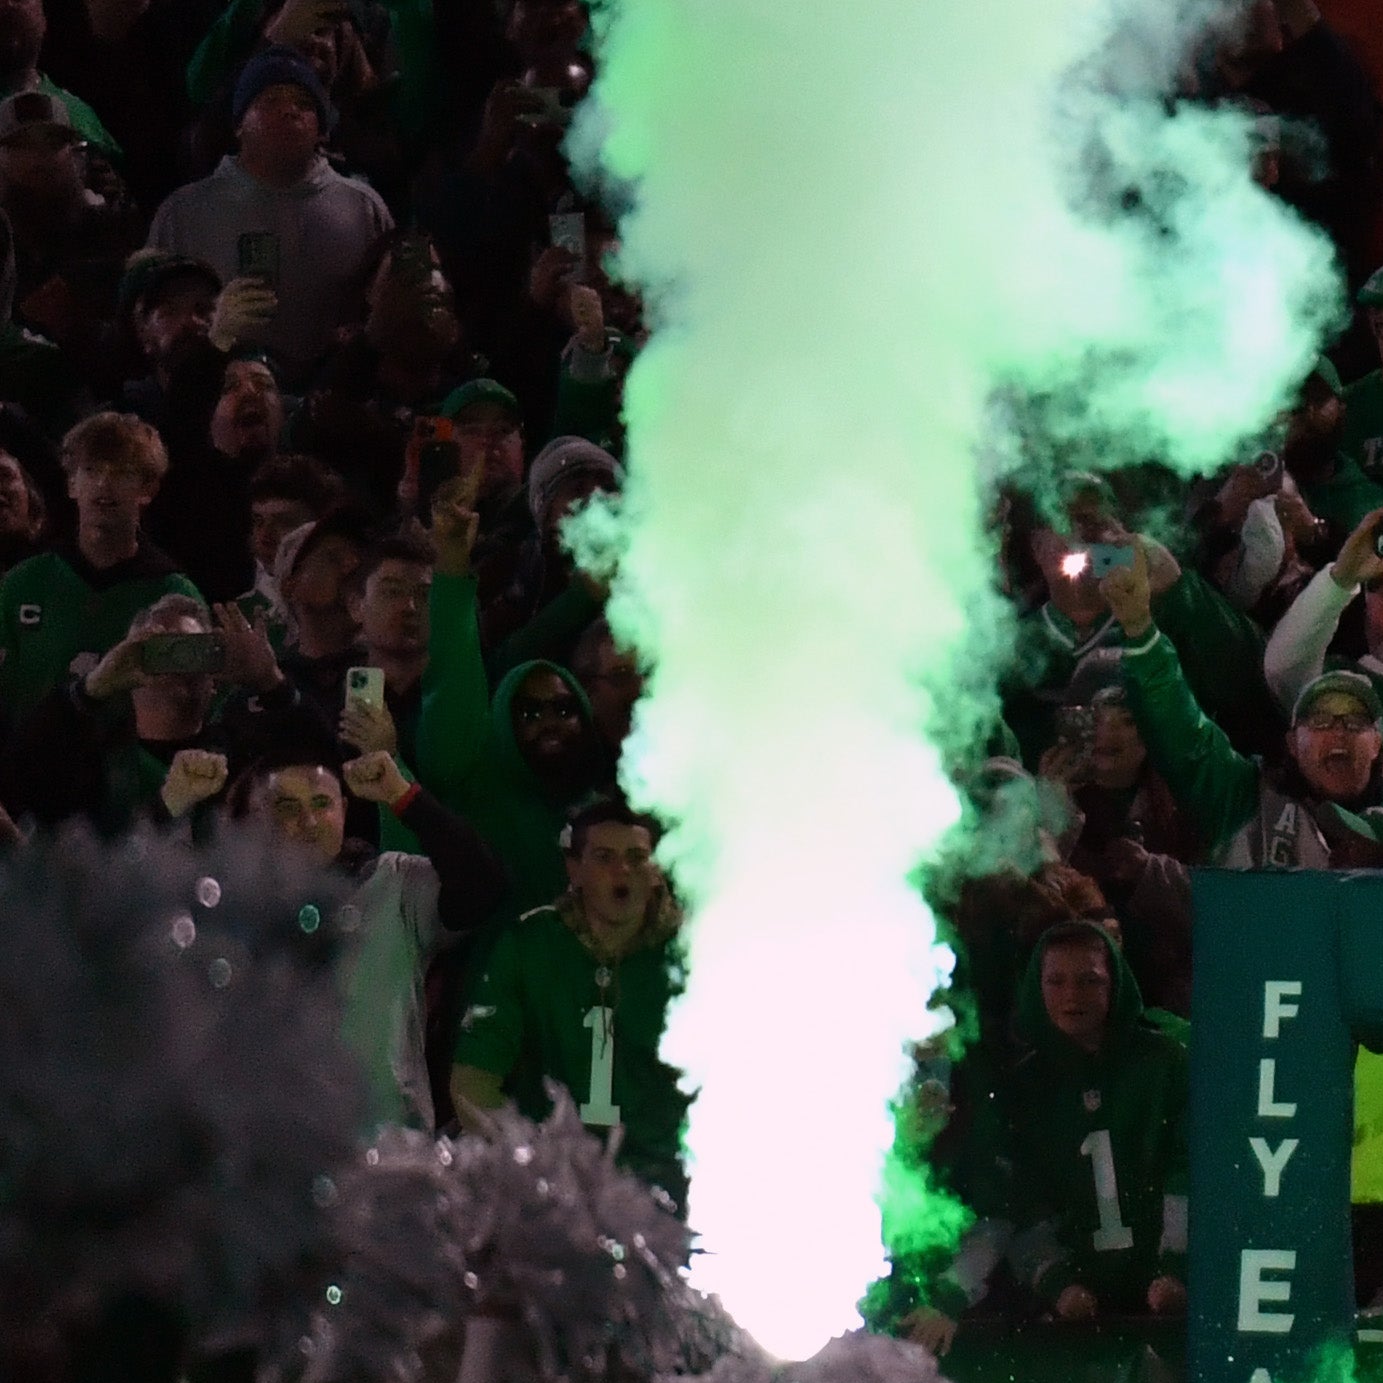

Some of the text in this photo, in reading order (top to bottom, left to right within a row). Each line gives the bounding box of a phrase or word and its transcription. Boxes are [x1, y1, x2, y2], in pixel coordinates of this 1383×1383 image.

[580, 1006, 622, 1126] 1
[1247, 980, 1303, 1198] FLY
[1080, 1129, 1133, 1252] 1
